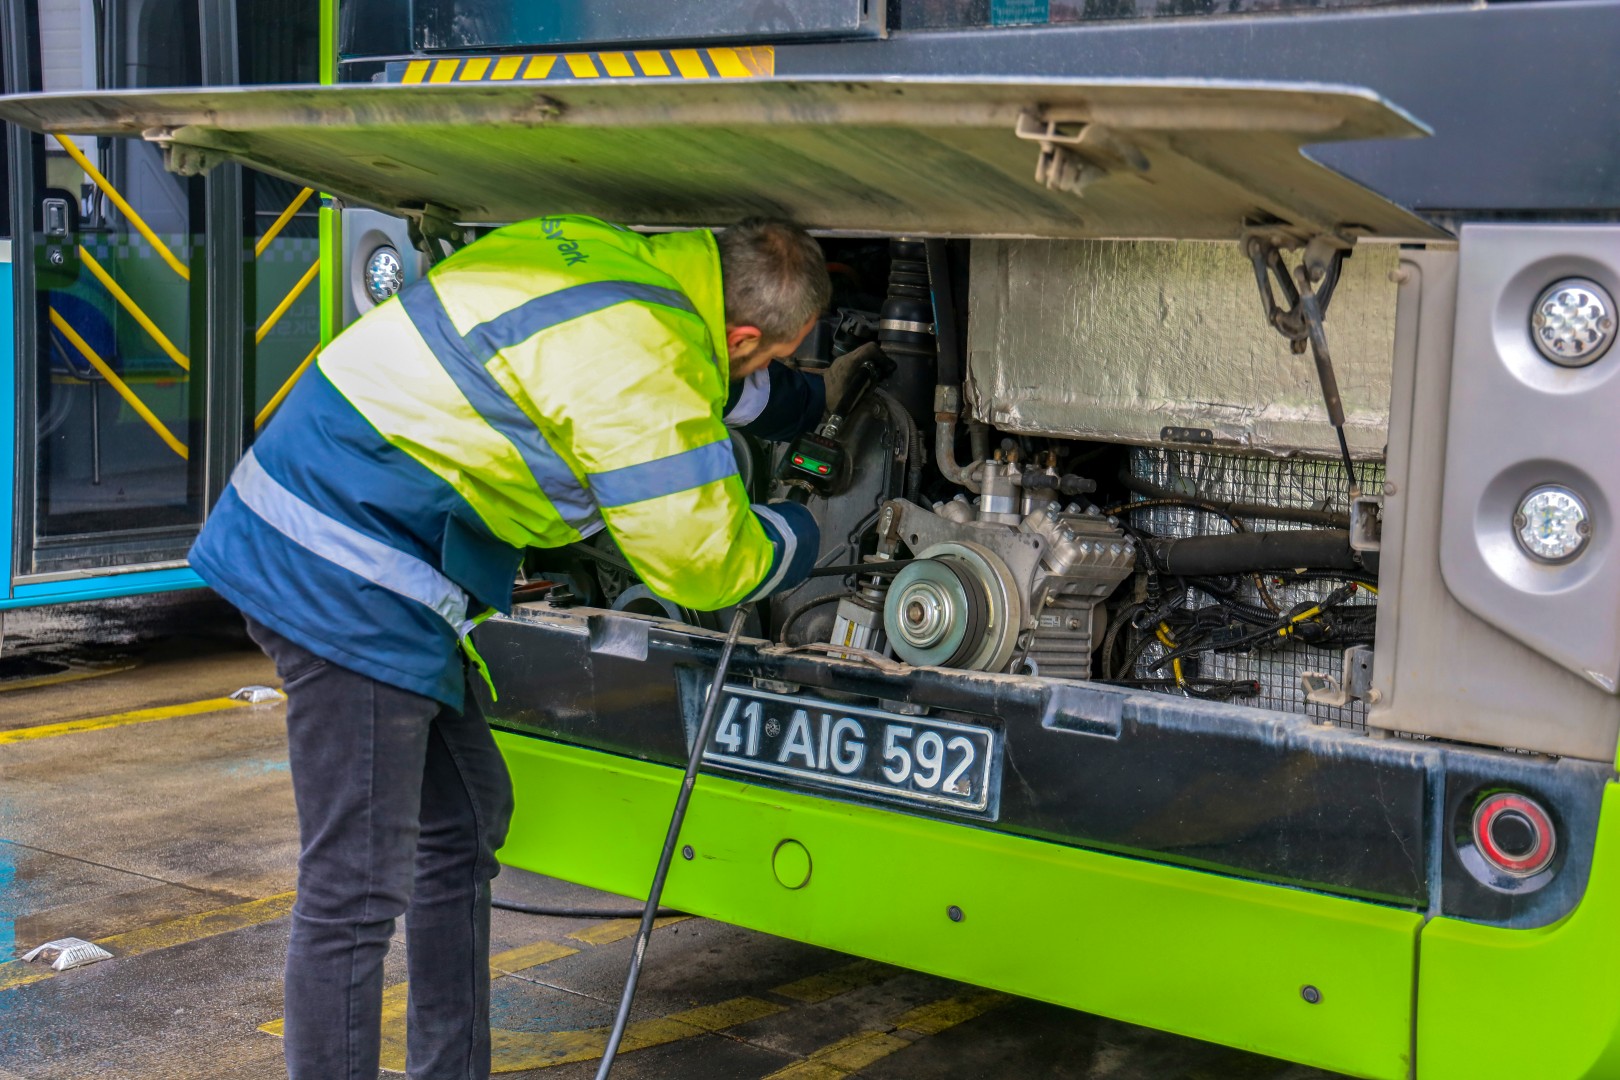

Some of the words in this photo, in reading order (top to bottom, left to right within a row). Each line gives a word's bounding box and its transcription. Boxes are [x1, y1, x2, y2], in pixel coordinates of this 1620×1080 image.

[716, 697, 760, 756] 41
[778, 709, 864, 774] AIG
[882, 724, 975, 797] 592
